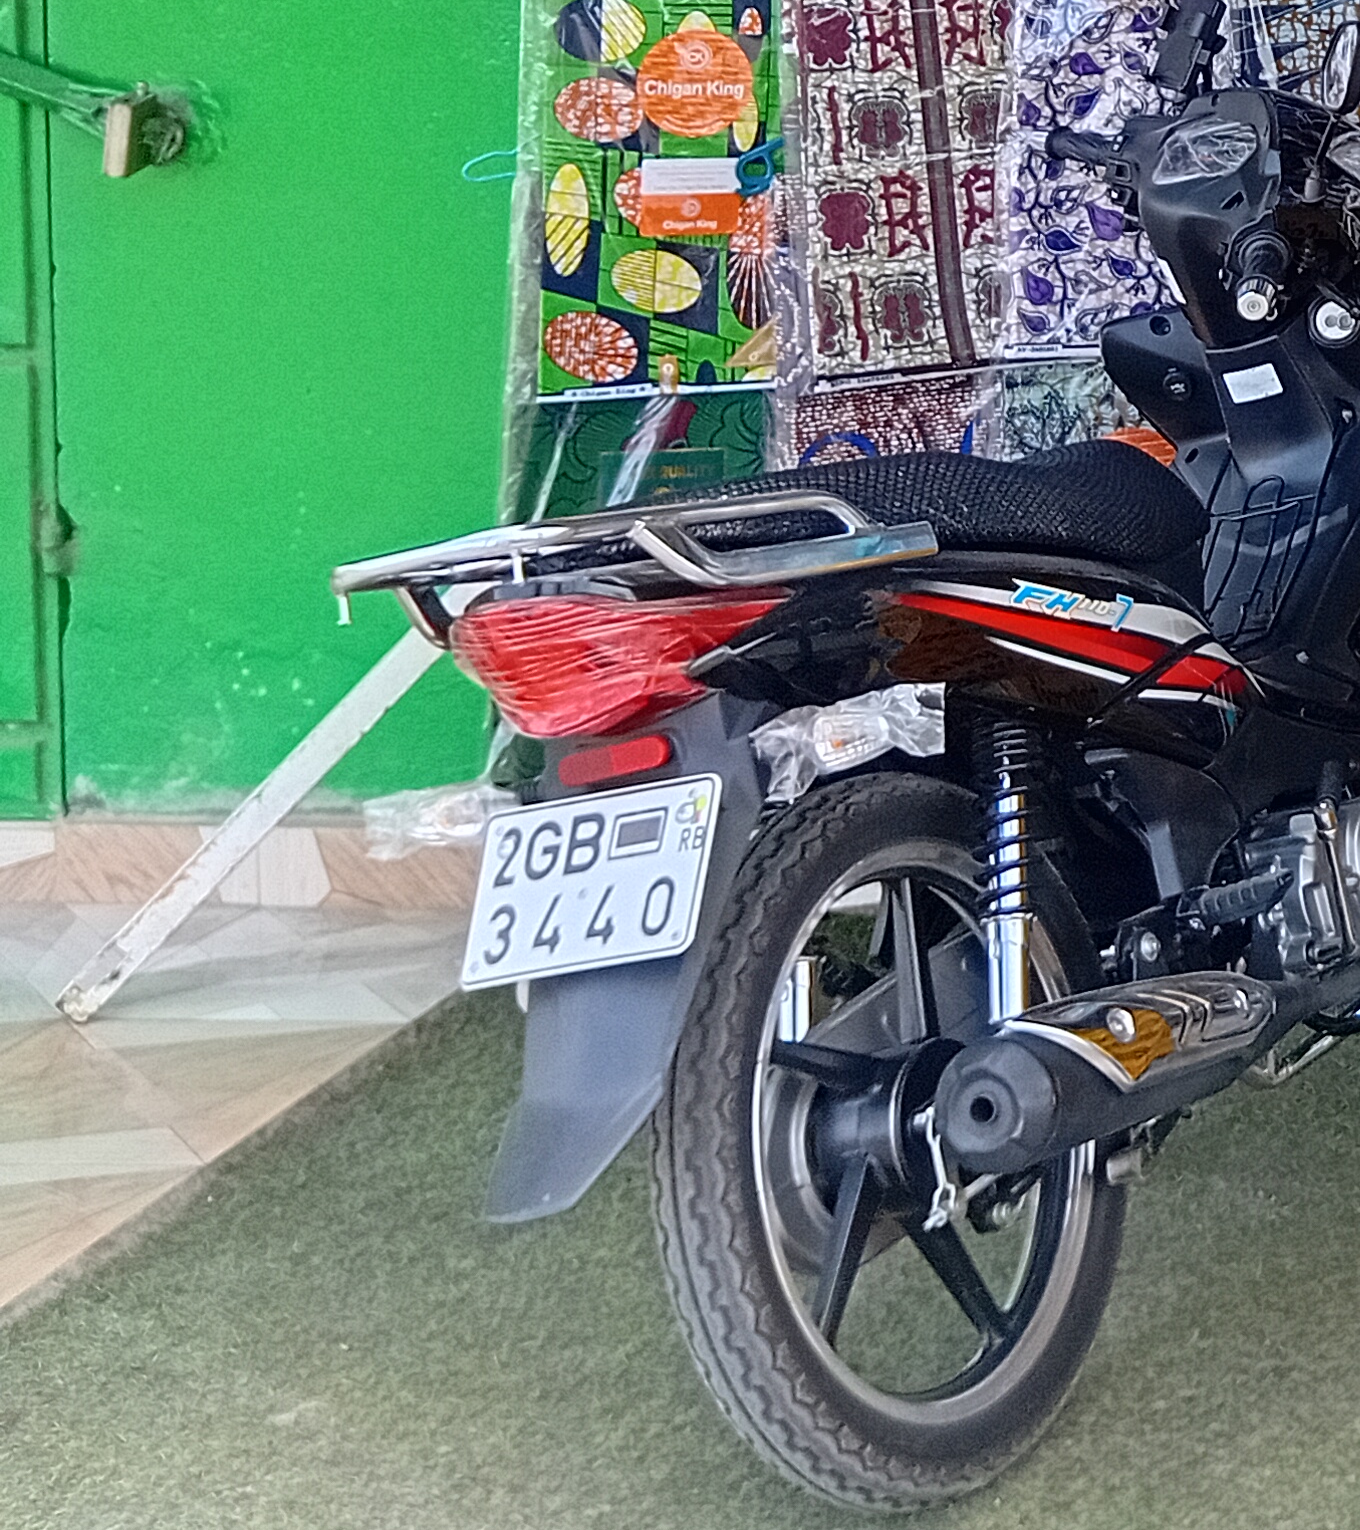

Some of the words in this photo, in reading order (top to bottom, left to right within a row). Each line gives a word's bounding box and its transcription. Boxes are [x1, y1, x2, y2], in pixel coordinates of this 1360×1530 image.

[644, 79, 703, 98] Chigan
[706, 80, 745, 99] King
[492, 811, 606, 890] 2GB
[678, 825, 706, 852] RB
[483, 875, 676, 966] 3440
